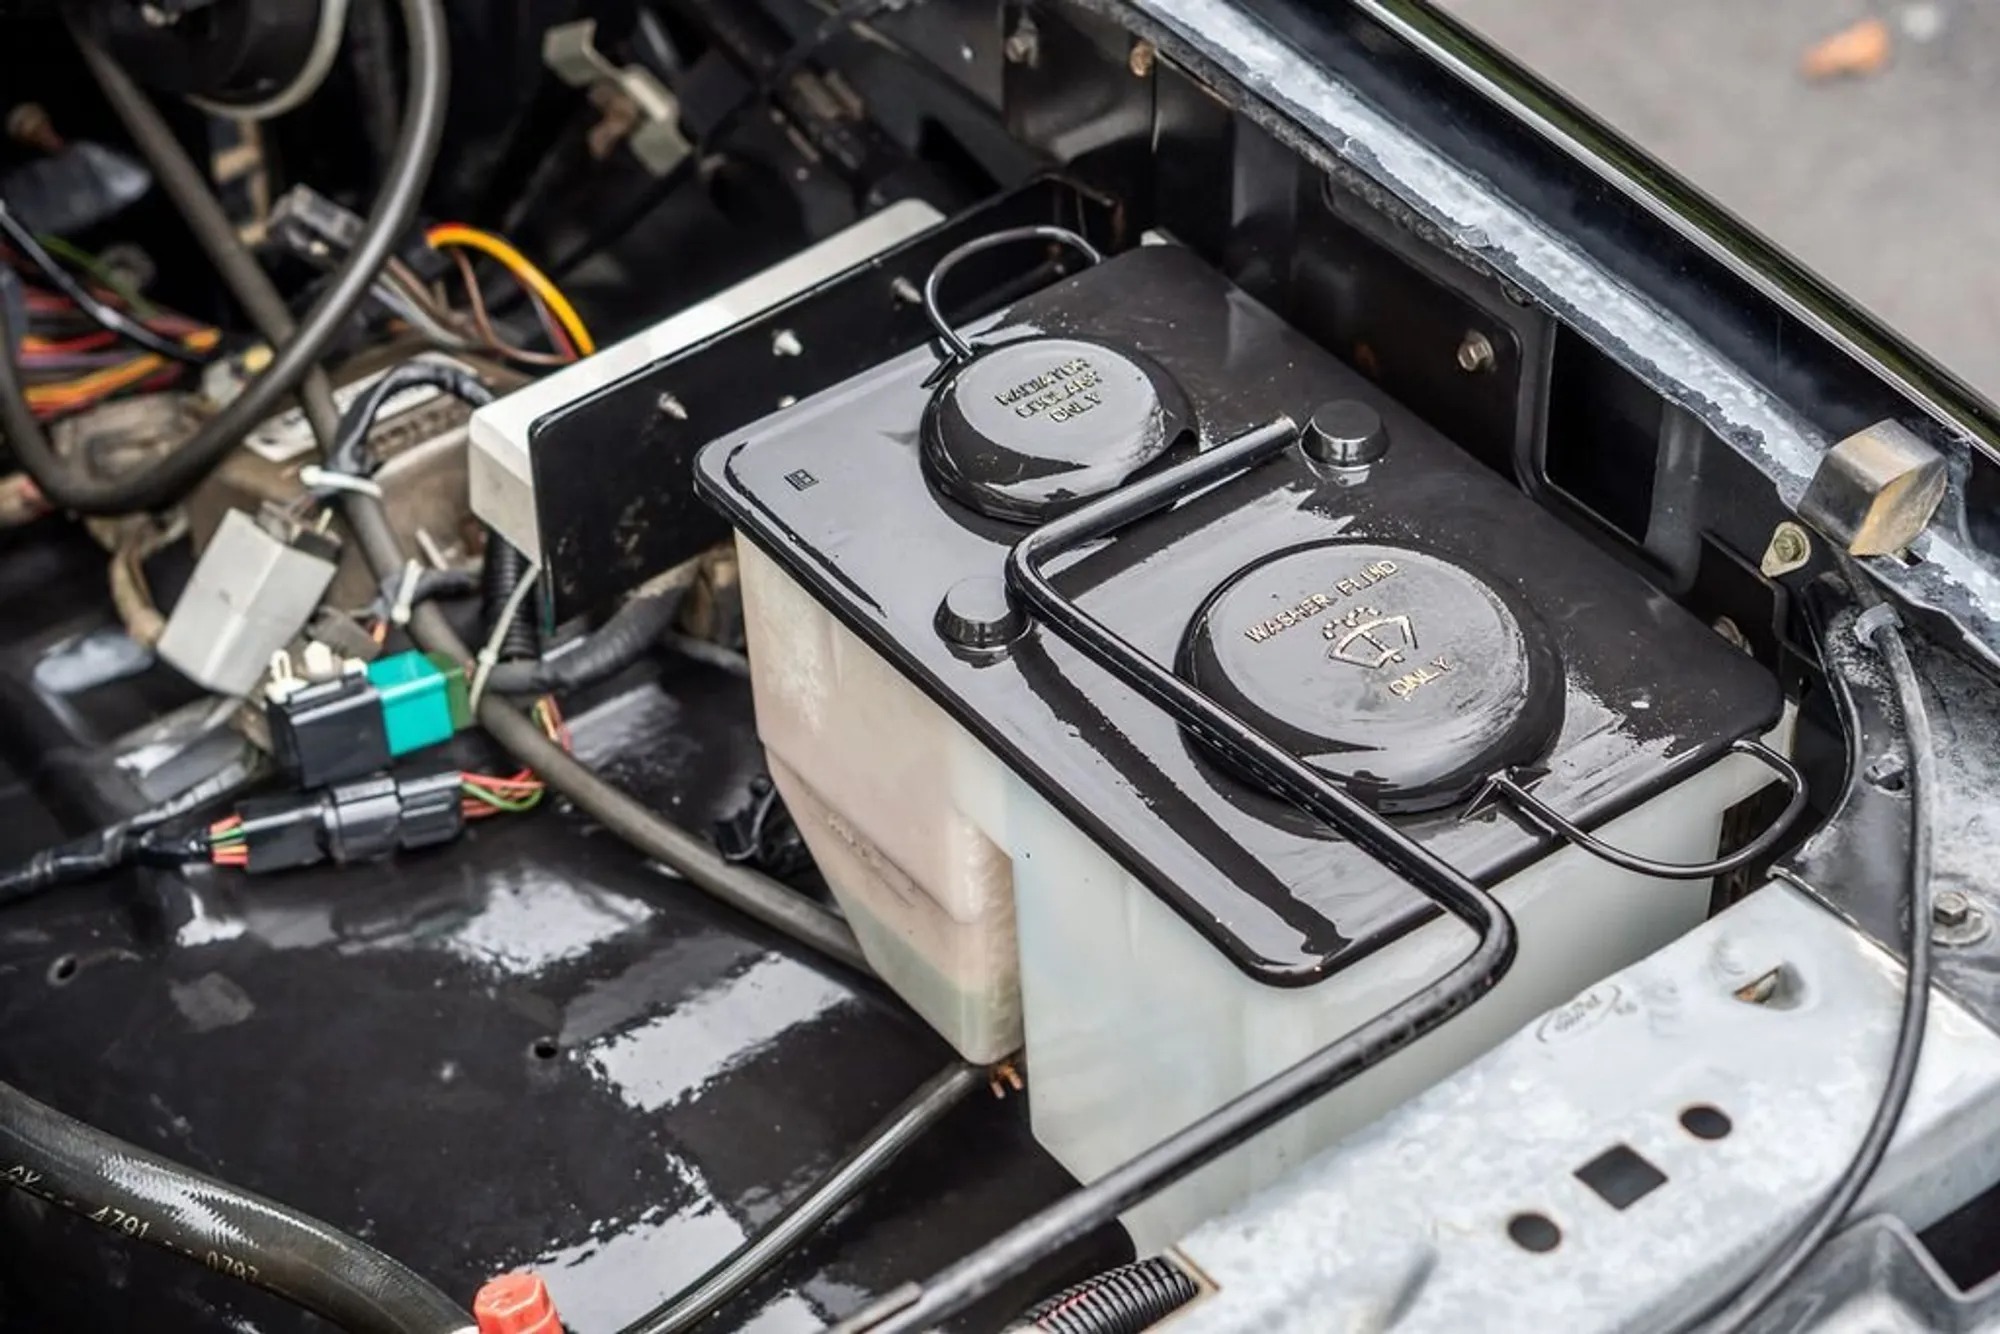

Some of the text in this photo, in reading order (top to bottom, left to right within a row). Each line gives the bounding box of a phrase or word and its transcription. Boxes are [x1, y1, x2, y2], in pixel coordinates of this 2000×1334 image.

[994, 358, 1091, 406] RADIATOR
[1015, 371, 1103, 418] COOLANT
[1048, 392, 1102, 422] ONLY
[1244, 560, 1399, 643] WASHER FLUID
[1388, 656, 1453, 697] ONLY
